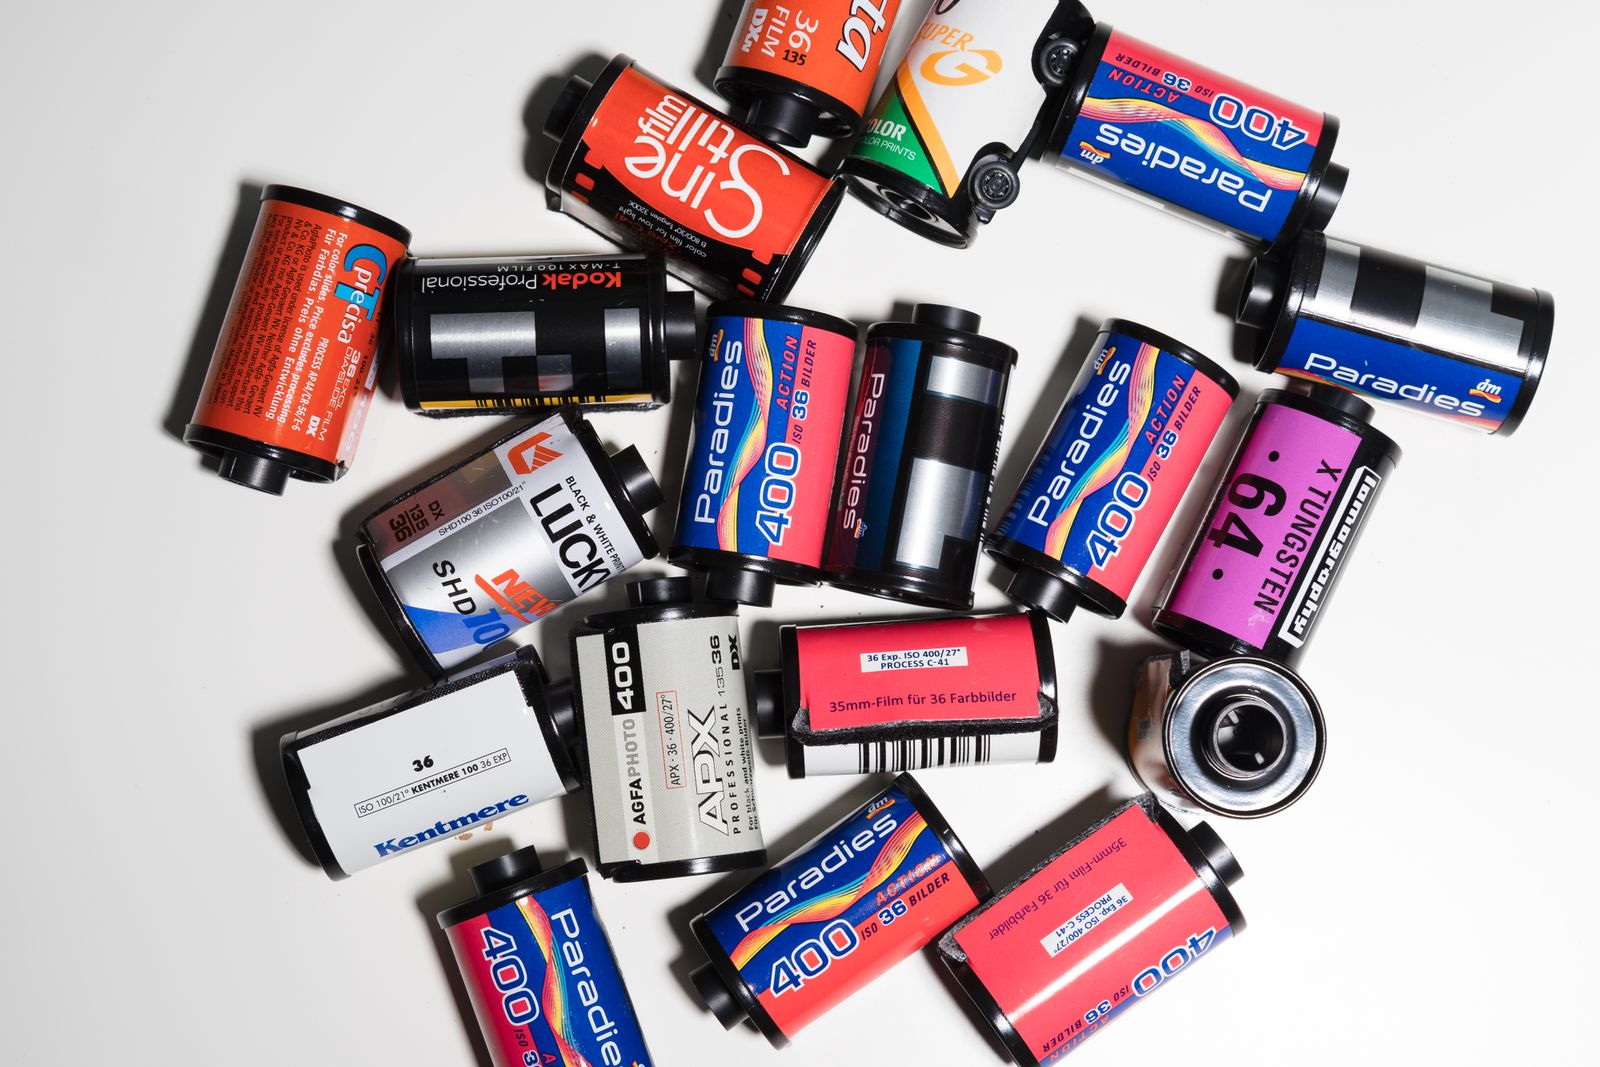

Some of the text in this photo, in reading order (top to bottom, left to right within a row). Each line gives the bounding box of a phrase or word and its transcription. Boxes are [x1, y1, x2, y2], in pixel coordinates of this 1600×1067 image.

[761, 5, 789, 58] FILM
[782, 49, 807, 66] 135
[788, 10, 818, 53] 36
[920, 49, 1003, 86] G
[1107, 64, 1180, 106] ACTION
[636, 89, 687, 142] film
[865, 117, 907, 141] OLOR
[1114, 50, 1310, 158] 400 ISO 36 BILDER
[880, 140, 917, 161] PRINTS
[1078, 148, 1104, 166] dm
[1093, 117, 1272, 216] Paradies
[300, 223, 322, 263] AgfaPhoto
[617, 204, 707, 259] color film for low light
[285, 292, 299, 314] under
[292, 272, 305, 291] used
[331, 265, 376, 346] precisa
[421, 271, 620, 292] Kodak Professional
[264, 228, 336, 423] Für Farbdias. Preis ohne Entwicklung.
[272, 344, 283, 354] of
[274, 232, 347, 427] For color slides. Price excludes processing.
[275, 315, 292, 343] license
[255, 353, 280, 404] Agfa-Gevaert
[310, 336, 329, 370] PROCESS
[345, 349, 361, 378] 36
[774, 335, 799, 410] ACTION
[252, 404, 263, 417] NV
[317, 345, 353, 441] DIA/SLIDE FILM
[334, 377, 351, 412] EXCL
[1141, 373, 1187, 444] ACTION
[1303, 350, 1486, 419] Paradies
[1475, 377, 1503, 396] dm
[305, 414, 320, 437] DX
[693, 338, 744, 524] Paradies
[751, 339, 817, 546] 400 ISO 36 BILDER
[842, 371, 885, 531] Paradies
[1026, 356, 1132, 528] Paradies
[1076, 385, 1202, 574] 400 ISO 36 BILDER
[387, 512, 414, 543] 36
[407, 503, 429, 531] 135
[427, 500, 444, 521] DX
[437, 512, 472, 536] SHD100
[471, 507, 483, 517] 36
[564, 475, 590, 511] BLACK
[585, 513, 597, 525] &
[592, 523, 615, 555] WHITE
[1208, 471, 1288, 559] 64
[1252, 458, 1342, 616] X TUNGSTEN
[1290, 473, 1377, 637] lomography
[430, 554, 512, 649] SHD 10
[491, 567, 560, 623] NEW
[709, 634, 726, 696] 135 36
[728, 633, 740, 670] DX
[880, 658, 949, 669] PROCESS C-41
[881, 653, 901, 662] Exp.
[904, 651, 919, 659] ISO
[922, 648, 960, 659] 400/27°
[735, 706, 744, 734] prints
[829, 688, 1016, 713] 35mm-Film für 36 Farbbilder
[611, 641, 646, 825] AGFAPHOTO 400
[660, 693, 680, 785] APX 36 400/27°
[738, 737, 747, 763] white
[357, 752, 508, 814] ISO 100/21° KENTMERE 100 36 EXP
[410, 754, 435, 773] 36
[686, 704, 729, 838] APX
[719, 703, 741, 833] PROFESSIONAL
[741, 766, 749, 784] and
[373, 790, 530, 858] Kentmere
[743, 787, 752, 812] black
[732, 809, 901, 933] Paradies
[986, 836, 1126, 941] 35mm-Film für 36 Farbbilder
[757, 871, 951, 1003] 400 ISO 36 BILDER
[1050, 894, 1128, 953] 36 Exp. ISO 400/27°
[1054, 893, 1112, 938] PROCESS C-41
[480, 925, 542, 1067] 400 ISO 3
[550, 907, 624, 1067] Paradie
[1040, 921, 1222, 1053] 400 ISO 36 BILDER
